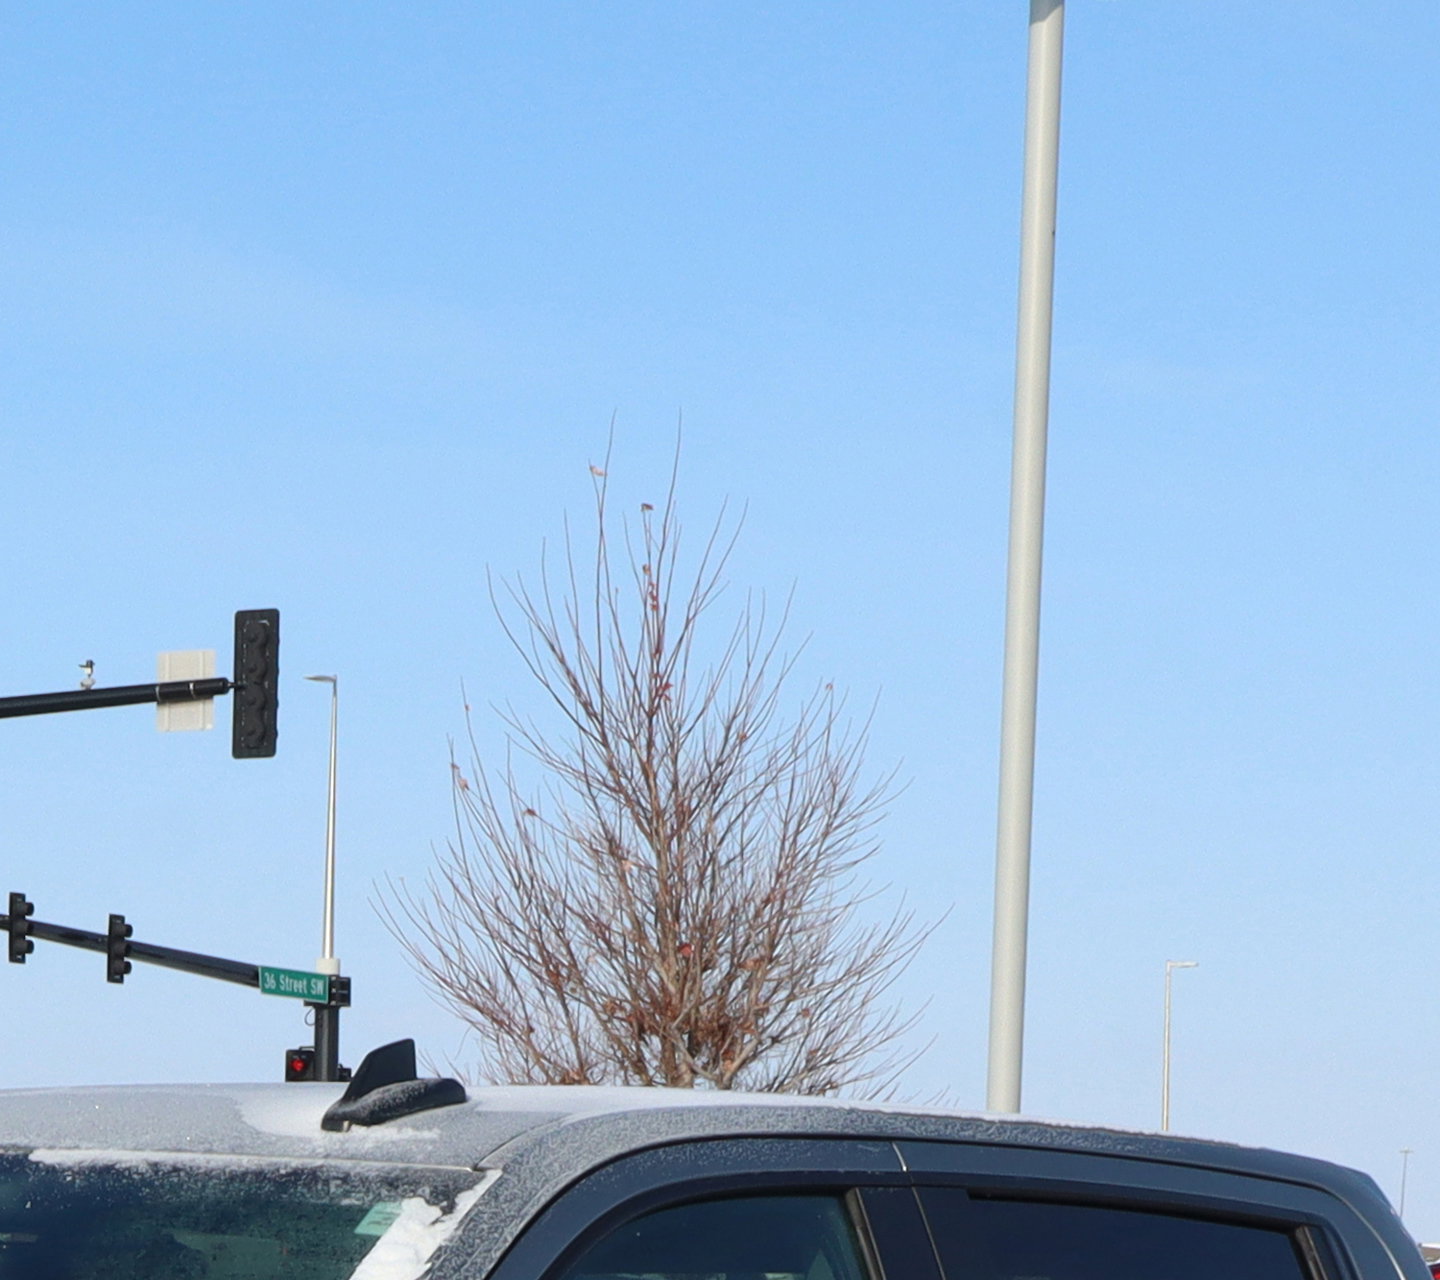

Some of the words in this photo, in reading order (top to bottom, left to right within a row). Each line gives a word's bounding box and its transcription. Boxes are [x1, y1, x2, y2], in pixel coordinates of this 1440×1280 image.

[264, 972, 276, 989] 36
[279, 974, 308, 994] Street
[311, 978, 324, 995] SW
